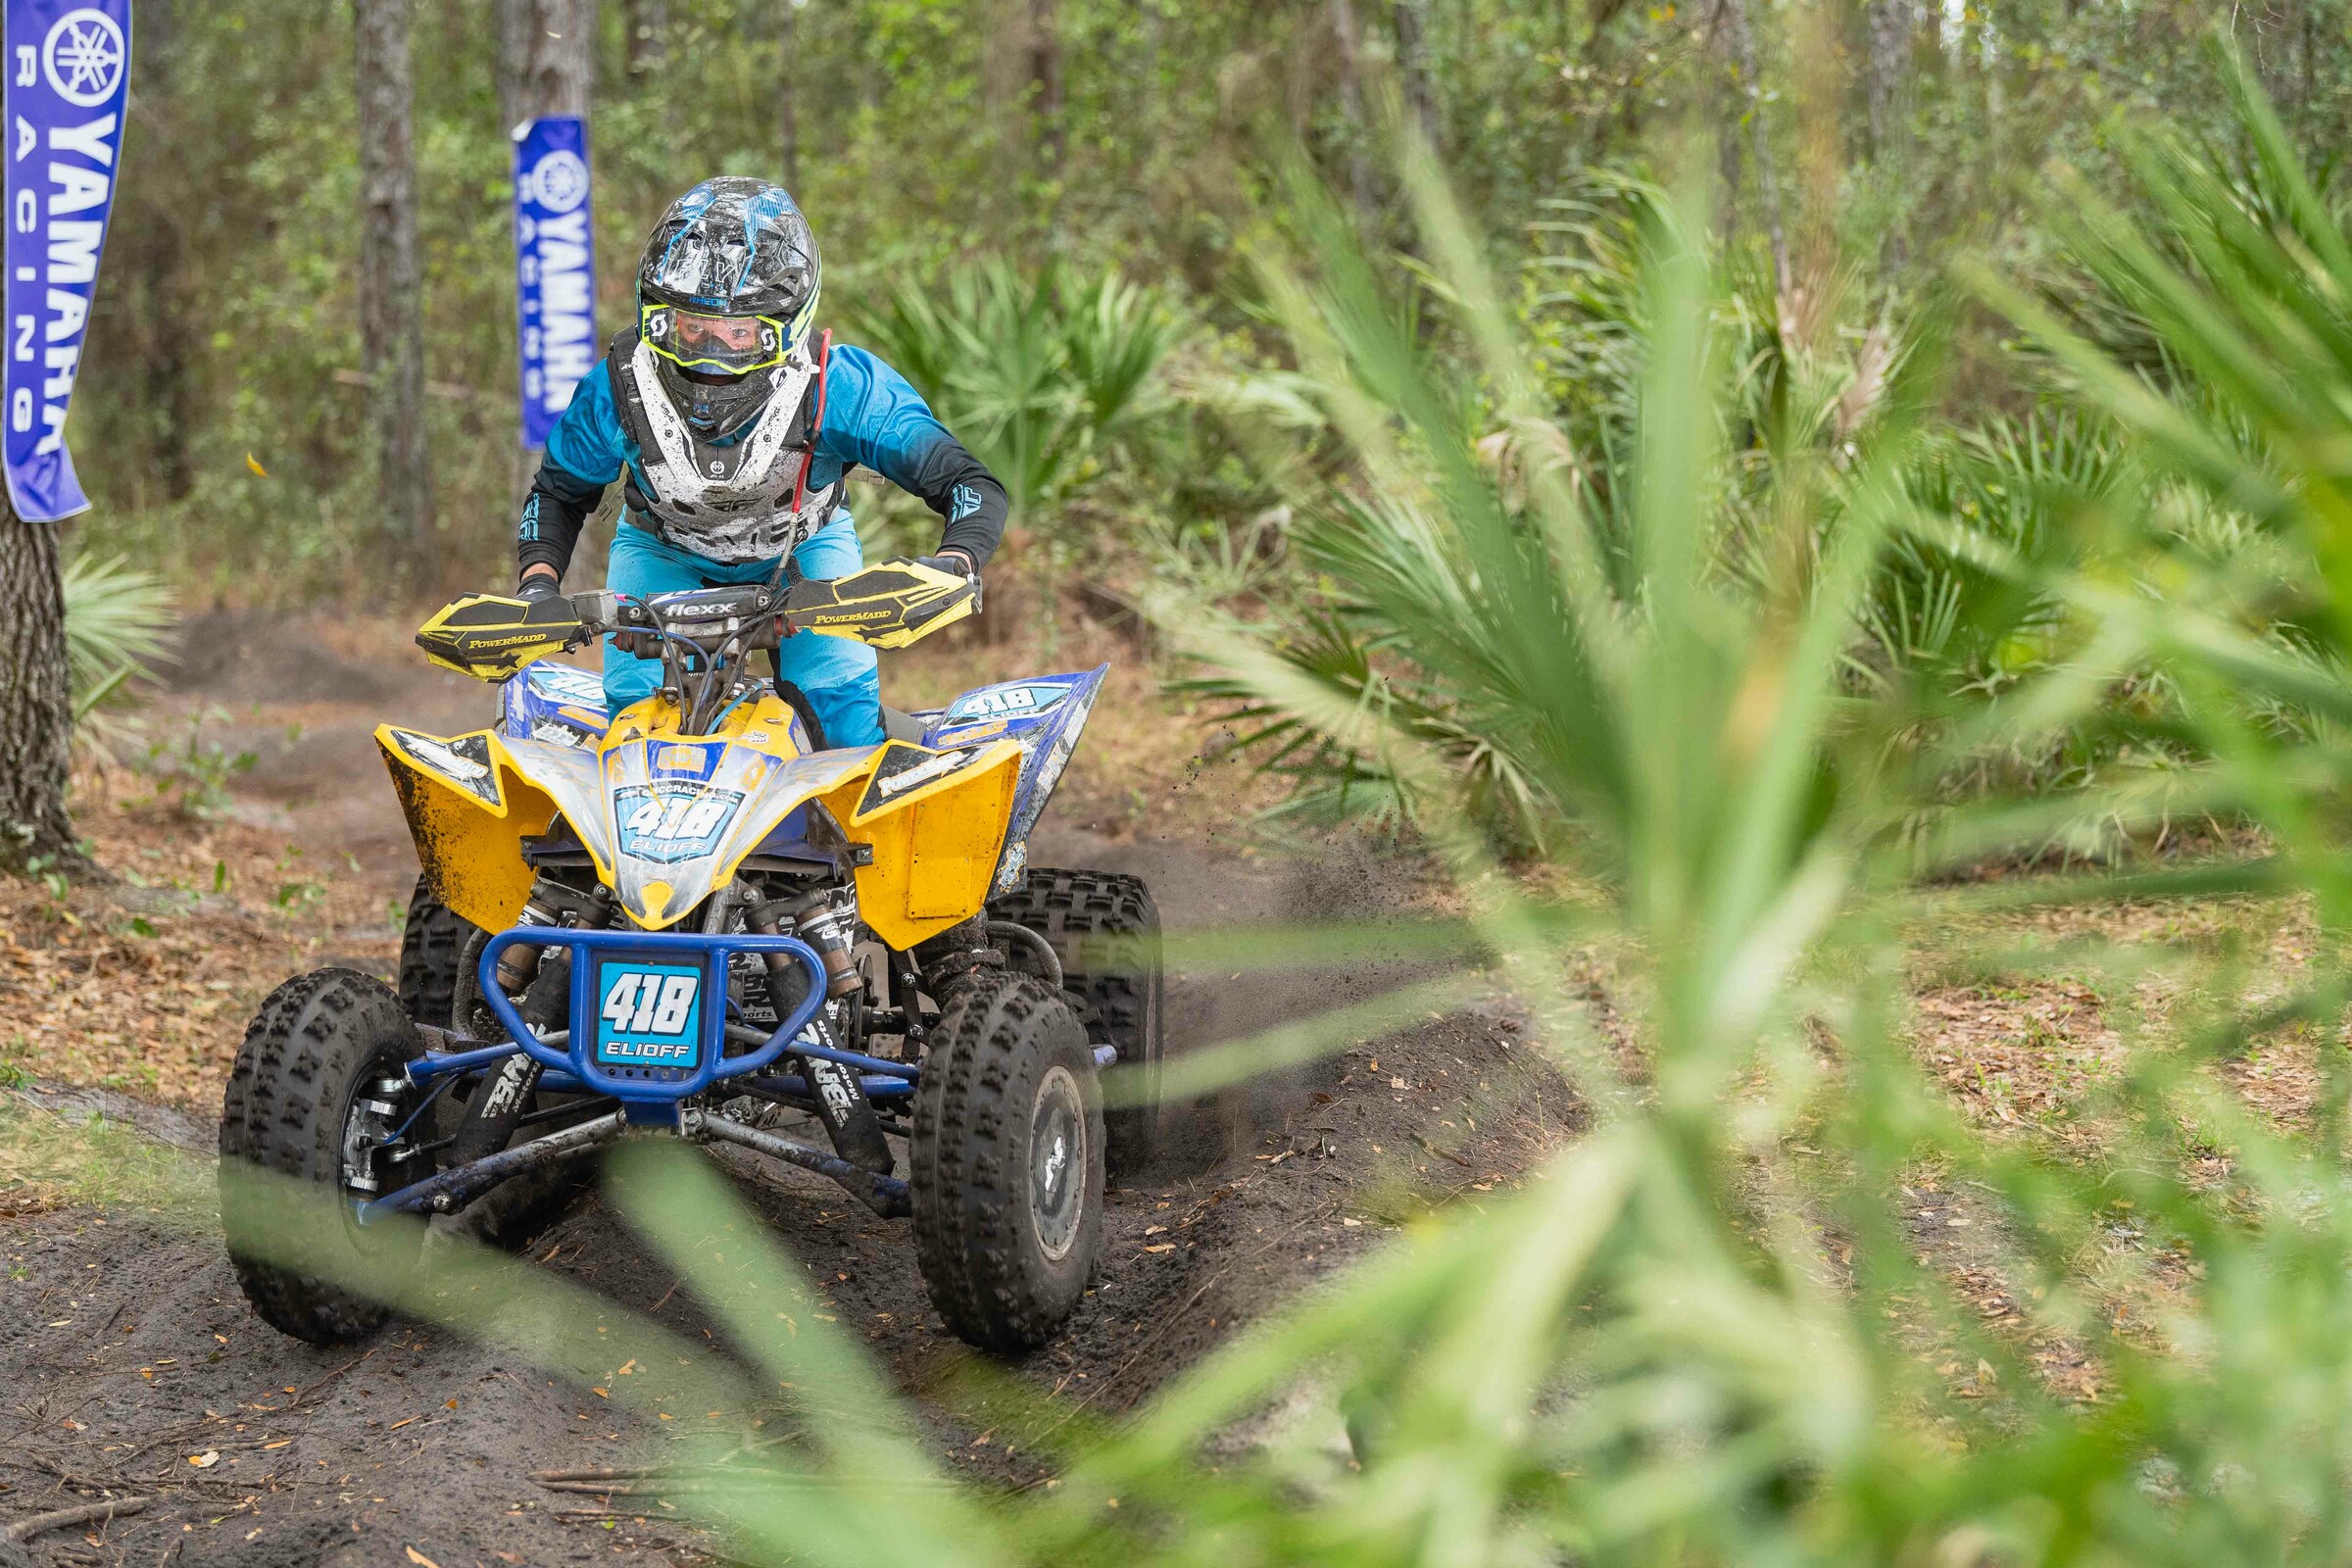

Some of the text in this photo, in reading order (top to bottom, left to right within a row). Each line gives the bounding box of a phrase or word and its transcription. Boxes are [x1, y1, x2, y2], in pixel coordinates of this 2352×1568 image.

[13, 45, 37, 433] RACING
[35, 111, 117, 456] YAMAHA
[538, 209, 593, 414] YAMAHA
[961, 687, 1038, 716] 418
[625, 795, 729, 841] 418
[628, 840, 709, 853] ELIOFF
[602, 972, 699, 1037] 418
[606, 1042, 690, 1058] ELIOFF
